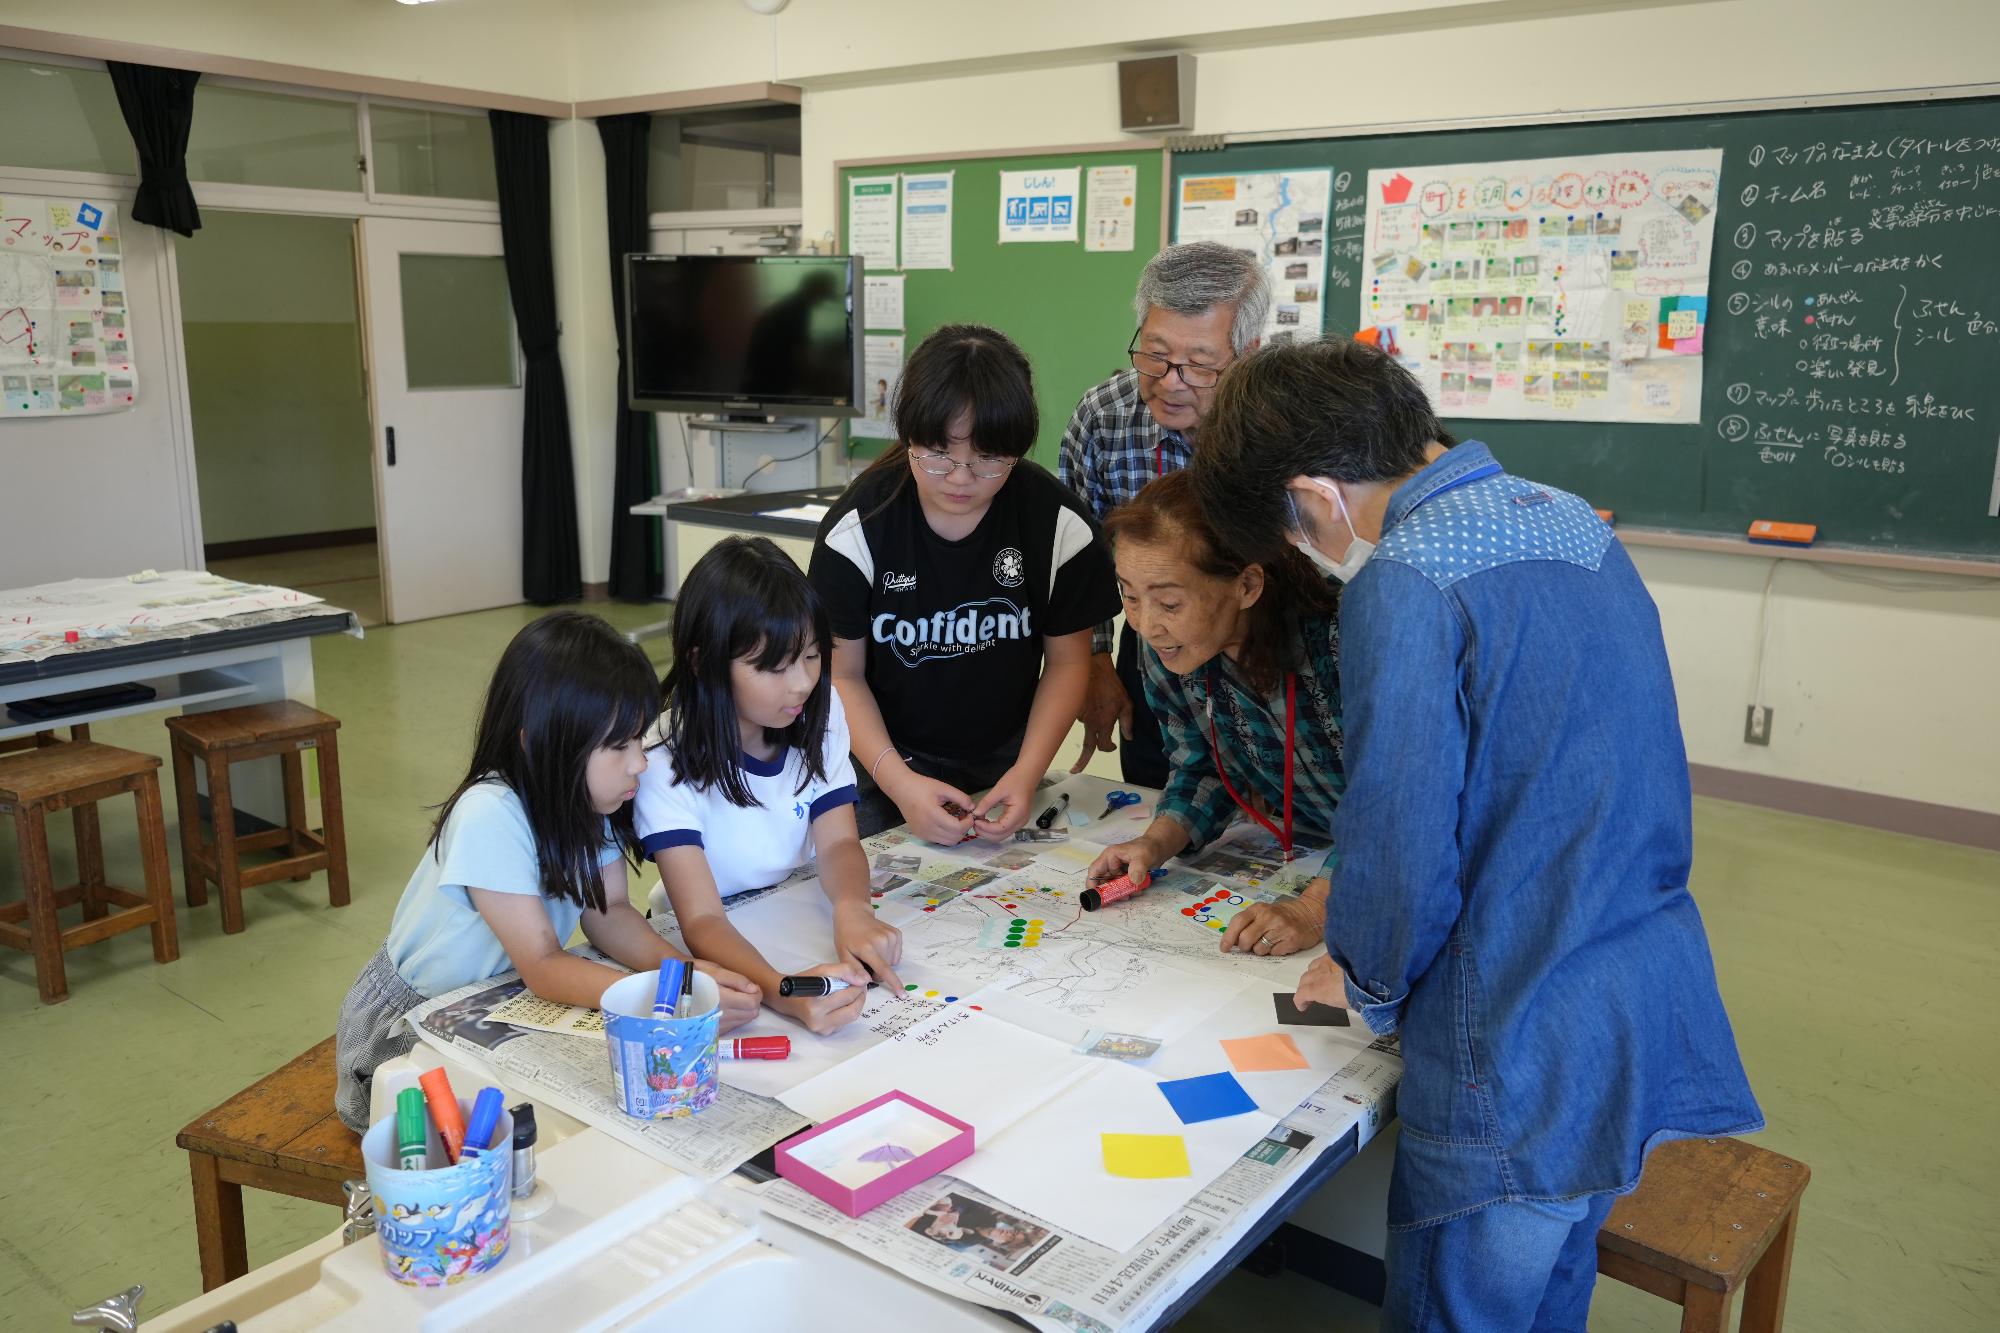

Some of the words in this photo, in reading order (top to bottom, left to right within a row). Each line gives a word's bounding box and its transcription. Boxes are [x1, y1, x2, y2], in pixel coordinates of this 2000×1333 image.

[1764, 181, 1827, 204] チーム名
[1765, 224, 1864, 250] マップを貼る
[1754, 315, 1793, 340] 意味
[1809, 356, 1887, 379] 楽しい発見
[872, 606, 1032, 646] Confident
[940, 642, 962, 653] with
[964, 638, 996, 654] delight
